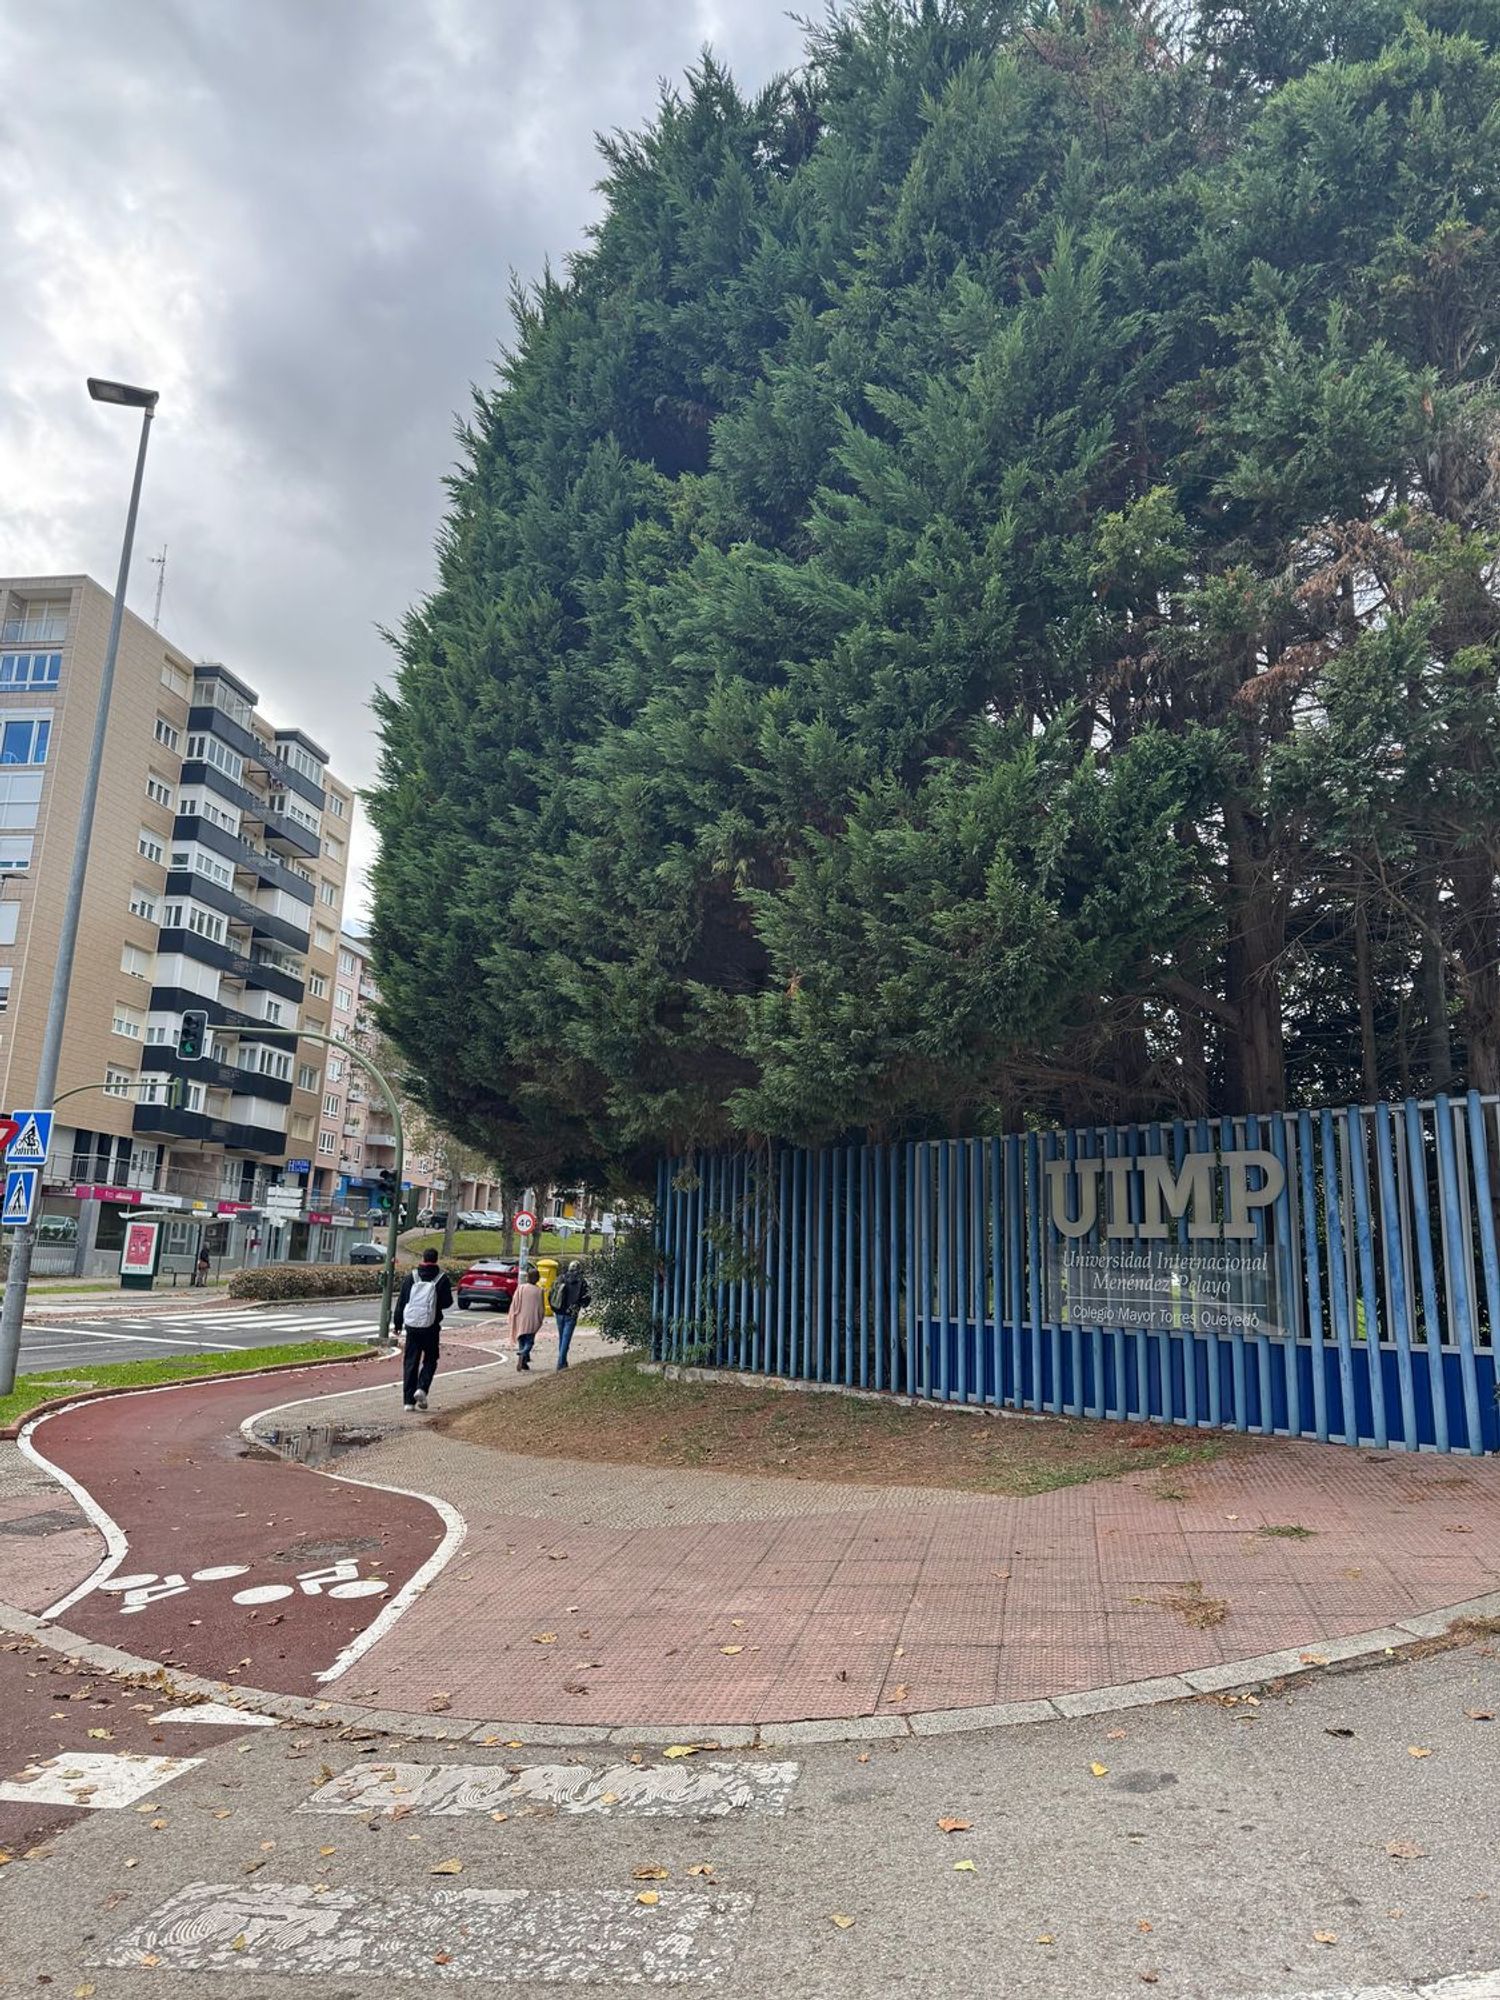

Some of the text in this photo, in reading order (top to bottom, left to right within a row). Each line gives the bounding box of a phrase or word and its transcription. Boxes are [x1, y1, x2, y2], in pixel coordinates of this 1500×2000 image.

[1045, 1150, 1285, 1238] UIMP
[518, 1218, 531, 1228] 40
[1063, 1250, 1267, 1271] Universidad Internacional
[1093, 1272, 1231, 1299] Menéndez Pelayo
[1073, 1304, 1115, 1323] Colegio
[1118, 1307, 1155, 1324] Mayor
[1201, 1311, 1260, 1328] Quevedo
